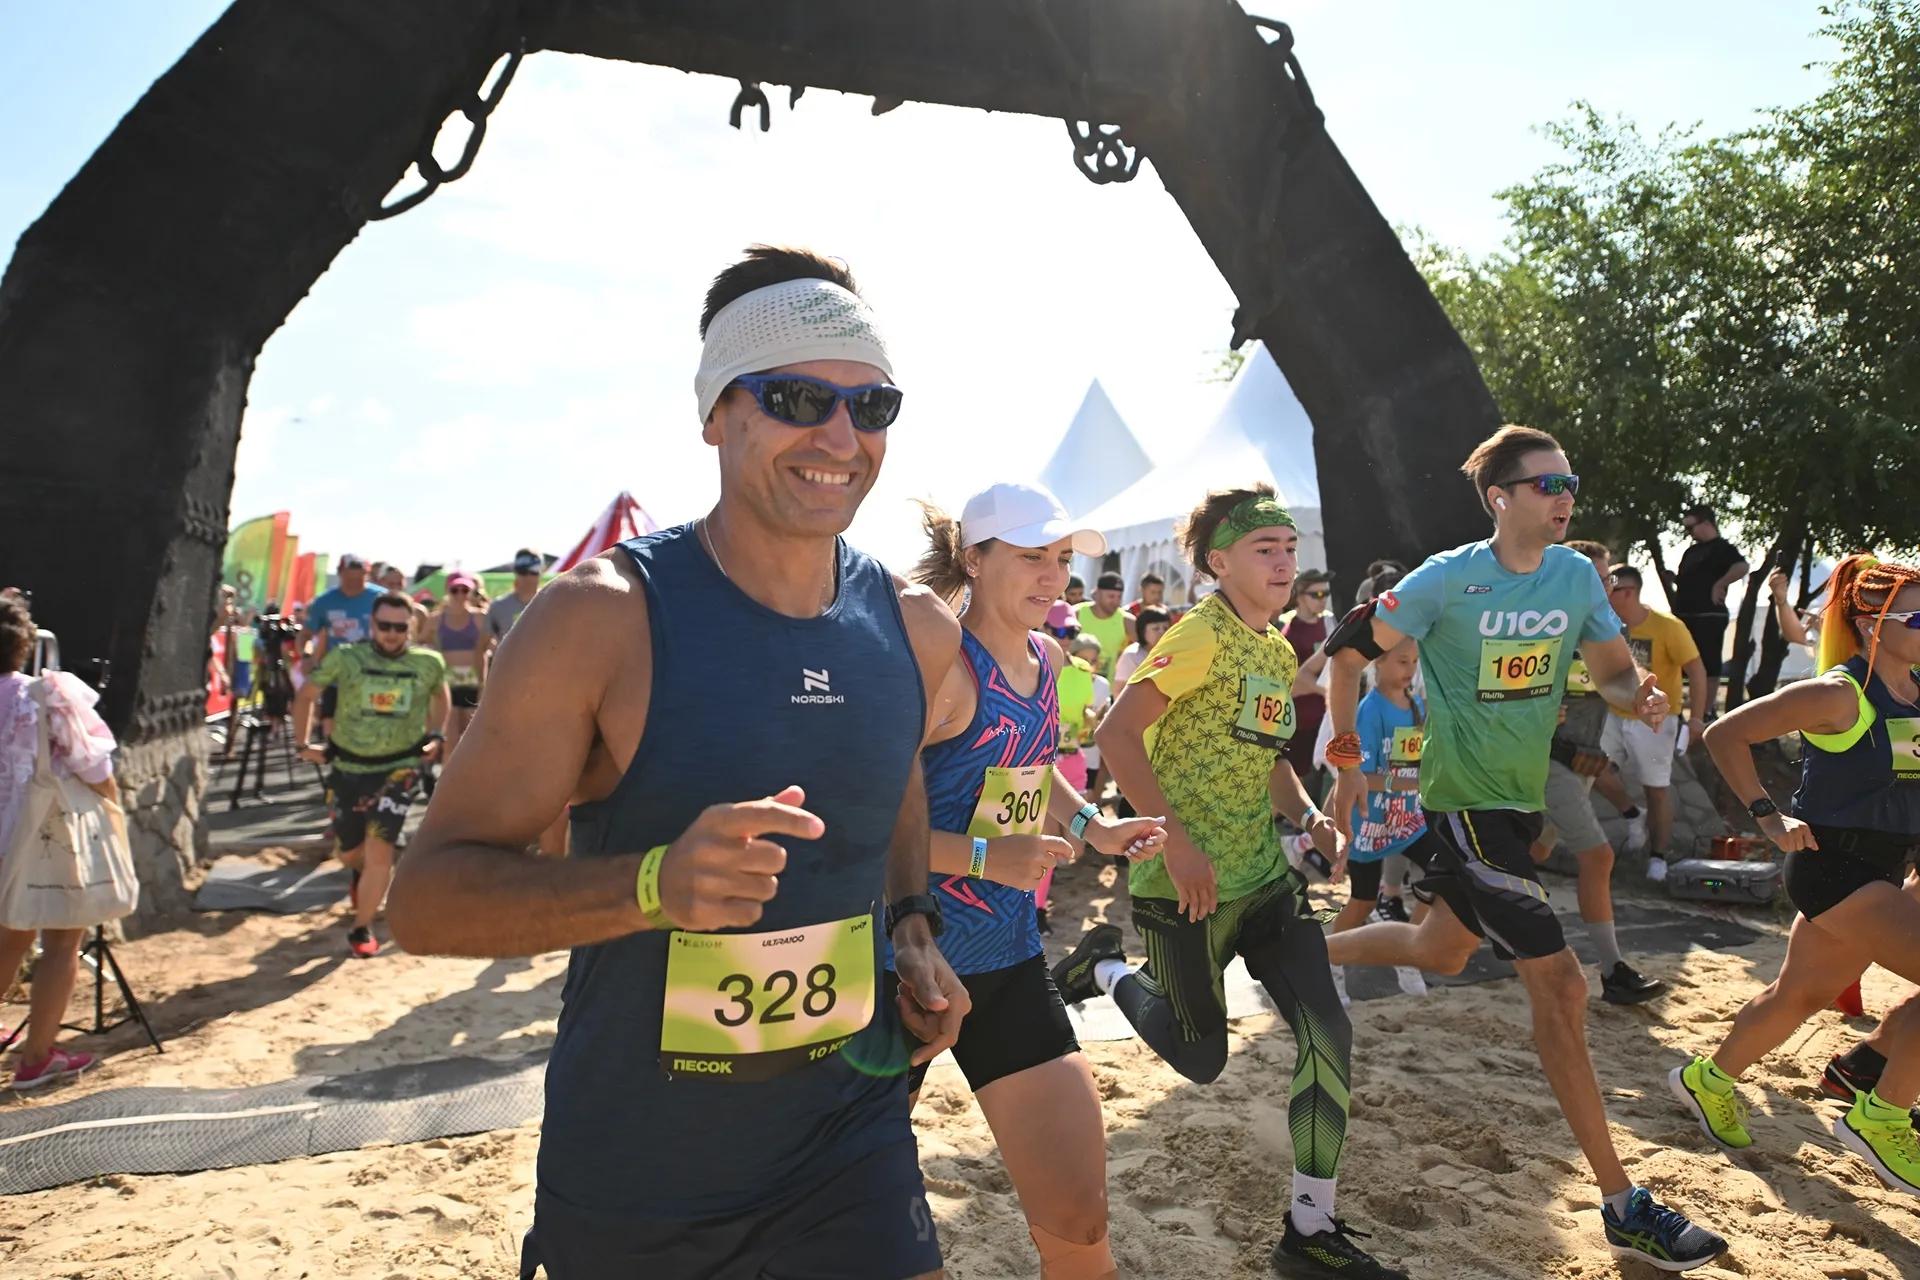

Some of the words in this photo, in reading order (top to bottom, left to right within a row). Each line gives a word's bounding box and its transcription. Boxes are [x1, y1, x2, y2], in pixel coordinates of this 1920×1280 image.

[1492, 654, 1552, 679] 1603
[791, 695, 845, 704] NORDSKI
[1481, 692, 1505, 700] ПЫЛЬ
[1254, 694, 1292, 727] 1528
[1236, 729, 1259, 742] ПЫЛЬ
[996, 789, 1042, 825] 360
[762, 934, 805, 948] ULTRA100
[714, 963, 837, 1027] 328
[809, 1046, 827, 1061] 10
[673, 1058, 733, 1074] ПЕСОК
